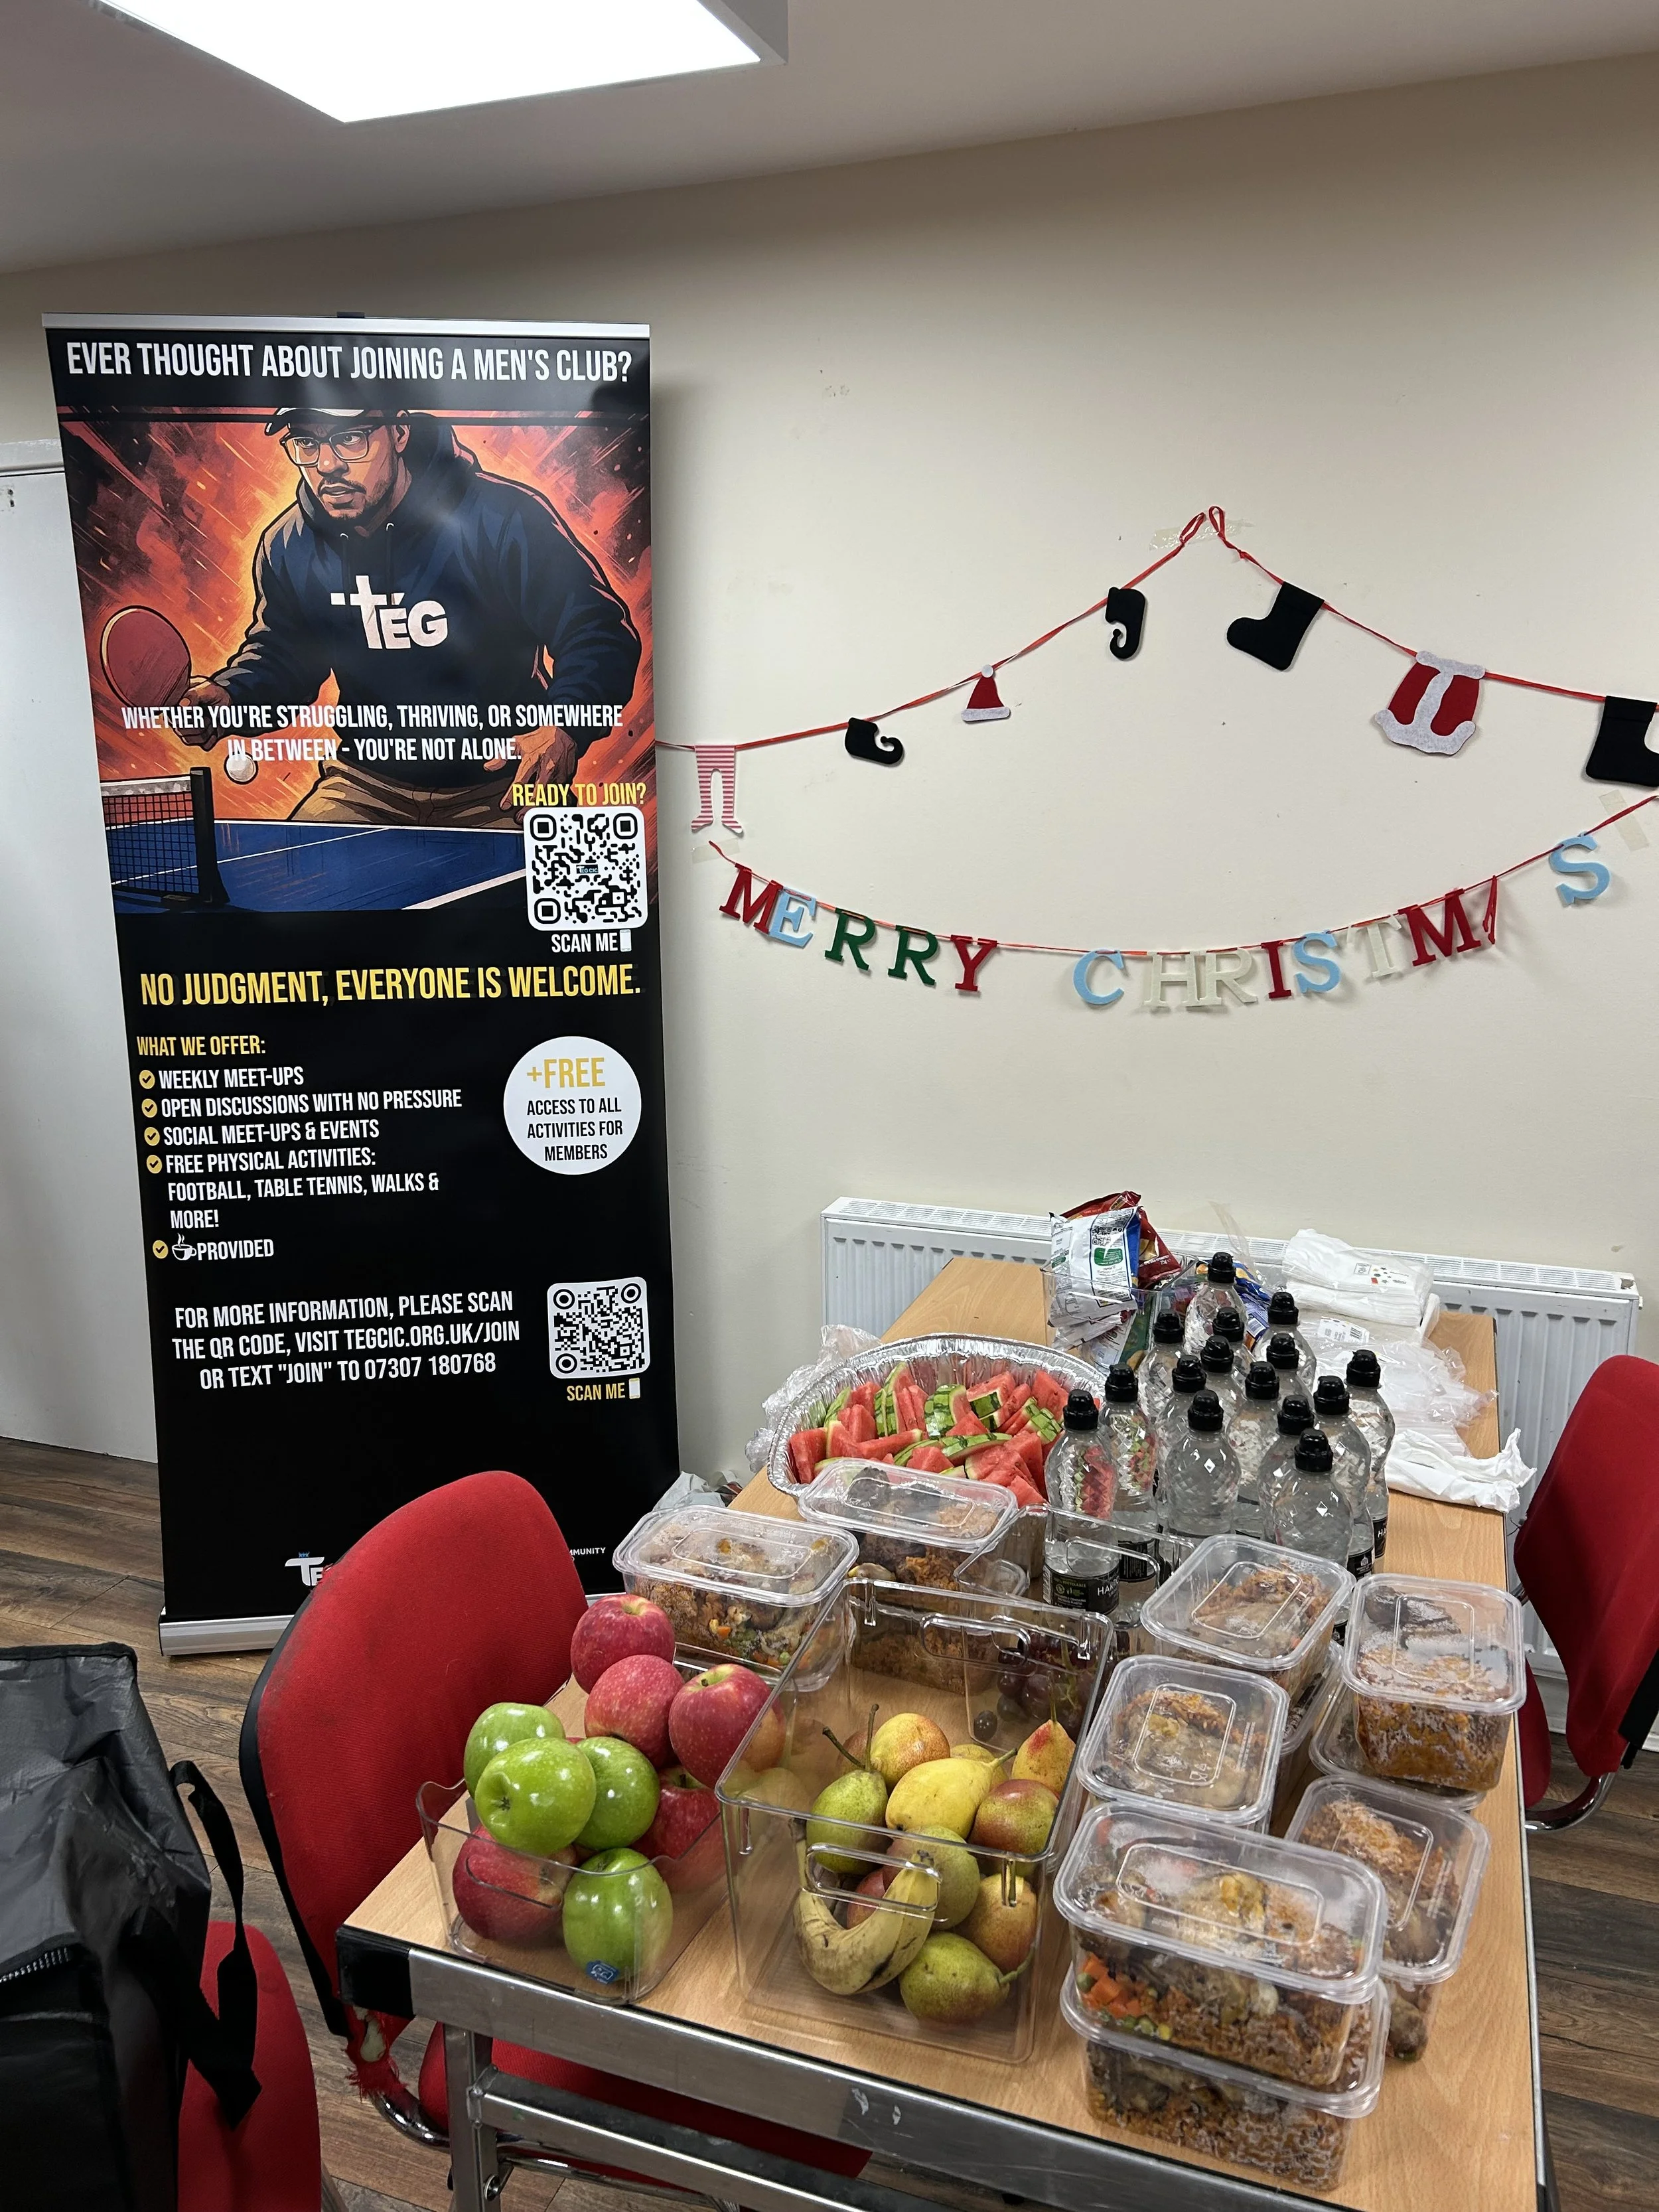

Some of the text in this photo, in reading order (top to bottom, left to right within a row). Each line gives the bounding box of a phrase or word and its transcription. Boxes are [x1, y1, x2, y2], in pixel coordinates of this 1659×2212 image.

[66, 342, 632, 382] EVER THOUGHT ABOUT JOINING A MEN'S CLUB?
[121, 704, 623, 731] WHETHER YOU'RE STRUGGLING, THRIVING, OR SOMEWHERE
[228, 739, 246, 761] IN
[251, 738, 337, 761] BETWEEN
[354, 738, 417, 761] YOU'RE
[421, 738, 456, 760] NOT
[461, 737, 522, 760] ALONE.
[512, 782, 646, 806] READY TO JOIN?
[719, 863, 997, 992] MERRY
[1073, 831, 1611, 1007] CHRISTMS
[551, 932, 618, 953] SCAN ME
[140, 964, 641, 1007] NO JUDGMENT, EVERYONE IS WELCOME.
[137, 1035, 265, 1056] WHAT WE OFFER:
[159, 1067, 304, 1089] WEEKLY MEET-UPS
[527, 1057, 605, 1089] +FREE
[161, 1089, 463, 1117] OPEN DISCUSSIONS WITH NO PRESSURE
[527, 1097, 622, 1116] ACCESS TO ALL
[163, 1119, 380, 1145] SOCIAL MEET-UPS & EVENTS
[527, 1120, 623, 1138] ACTIVITIES FOR
[166, 1147, 376, 1173] FREE PHYSICAL ACTIVITIES:
[544, 1143, 608, 1161] MEMBERS
[168, 1172, 439, 1201] FOOTBALL, TABLE TENNIS, WALKS &
[170, 1209, 220, 1228] MORE!
[197, 1239, 274, 1260] PROVIDED
[175, 1290, 513, 1329] FOR MORE INFORMATION, PLEASE SCAN
[172, 1321, 520, 1359] THE QR CODE, VISIT TEGCIC.ORG.UK/JOIN
[200, 1353, 496, 1389] OR TEXT "JOIN" TO 07307 180768
[567, 1382, 626, 1401] SCAN ME
